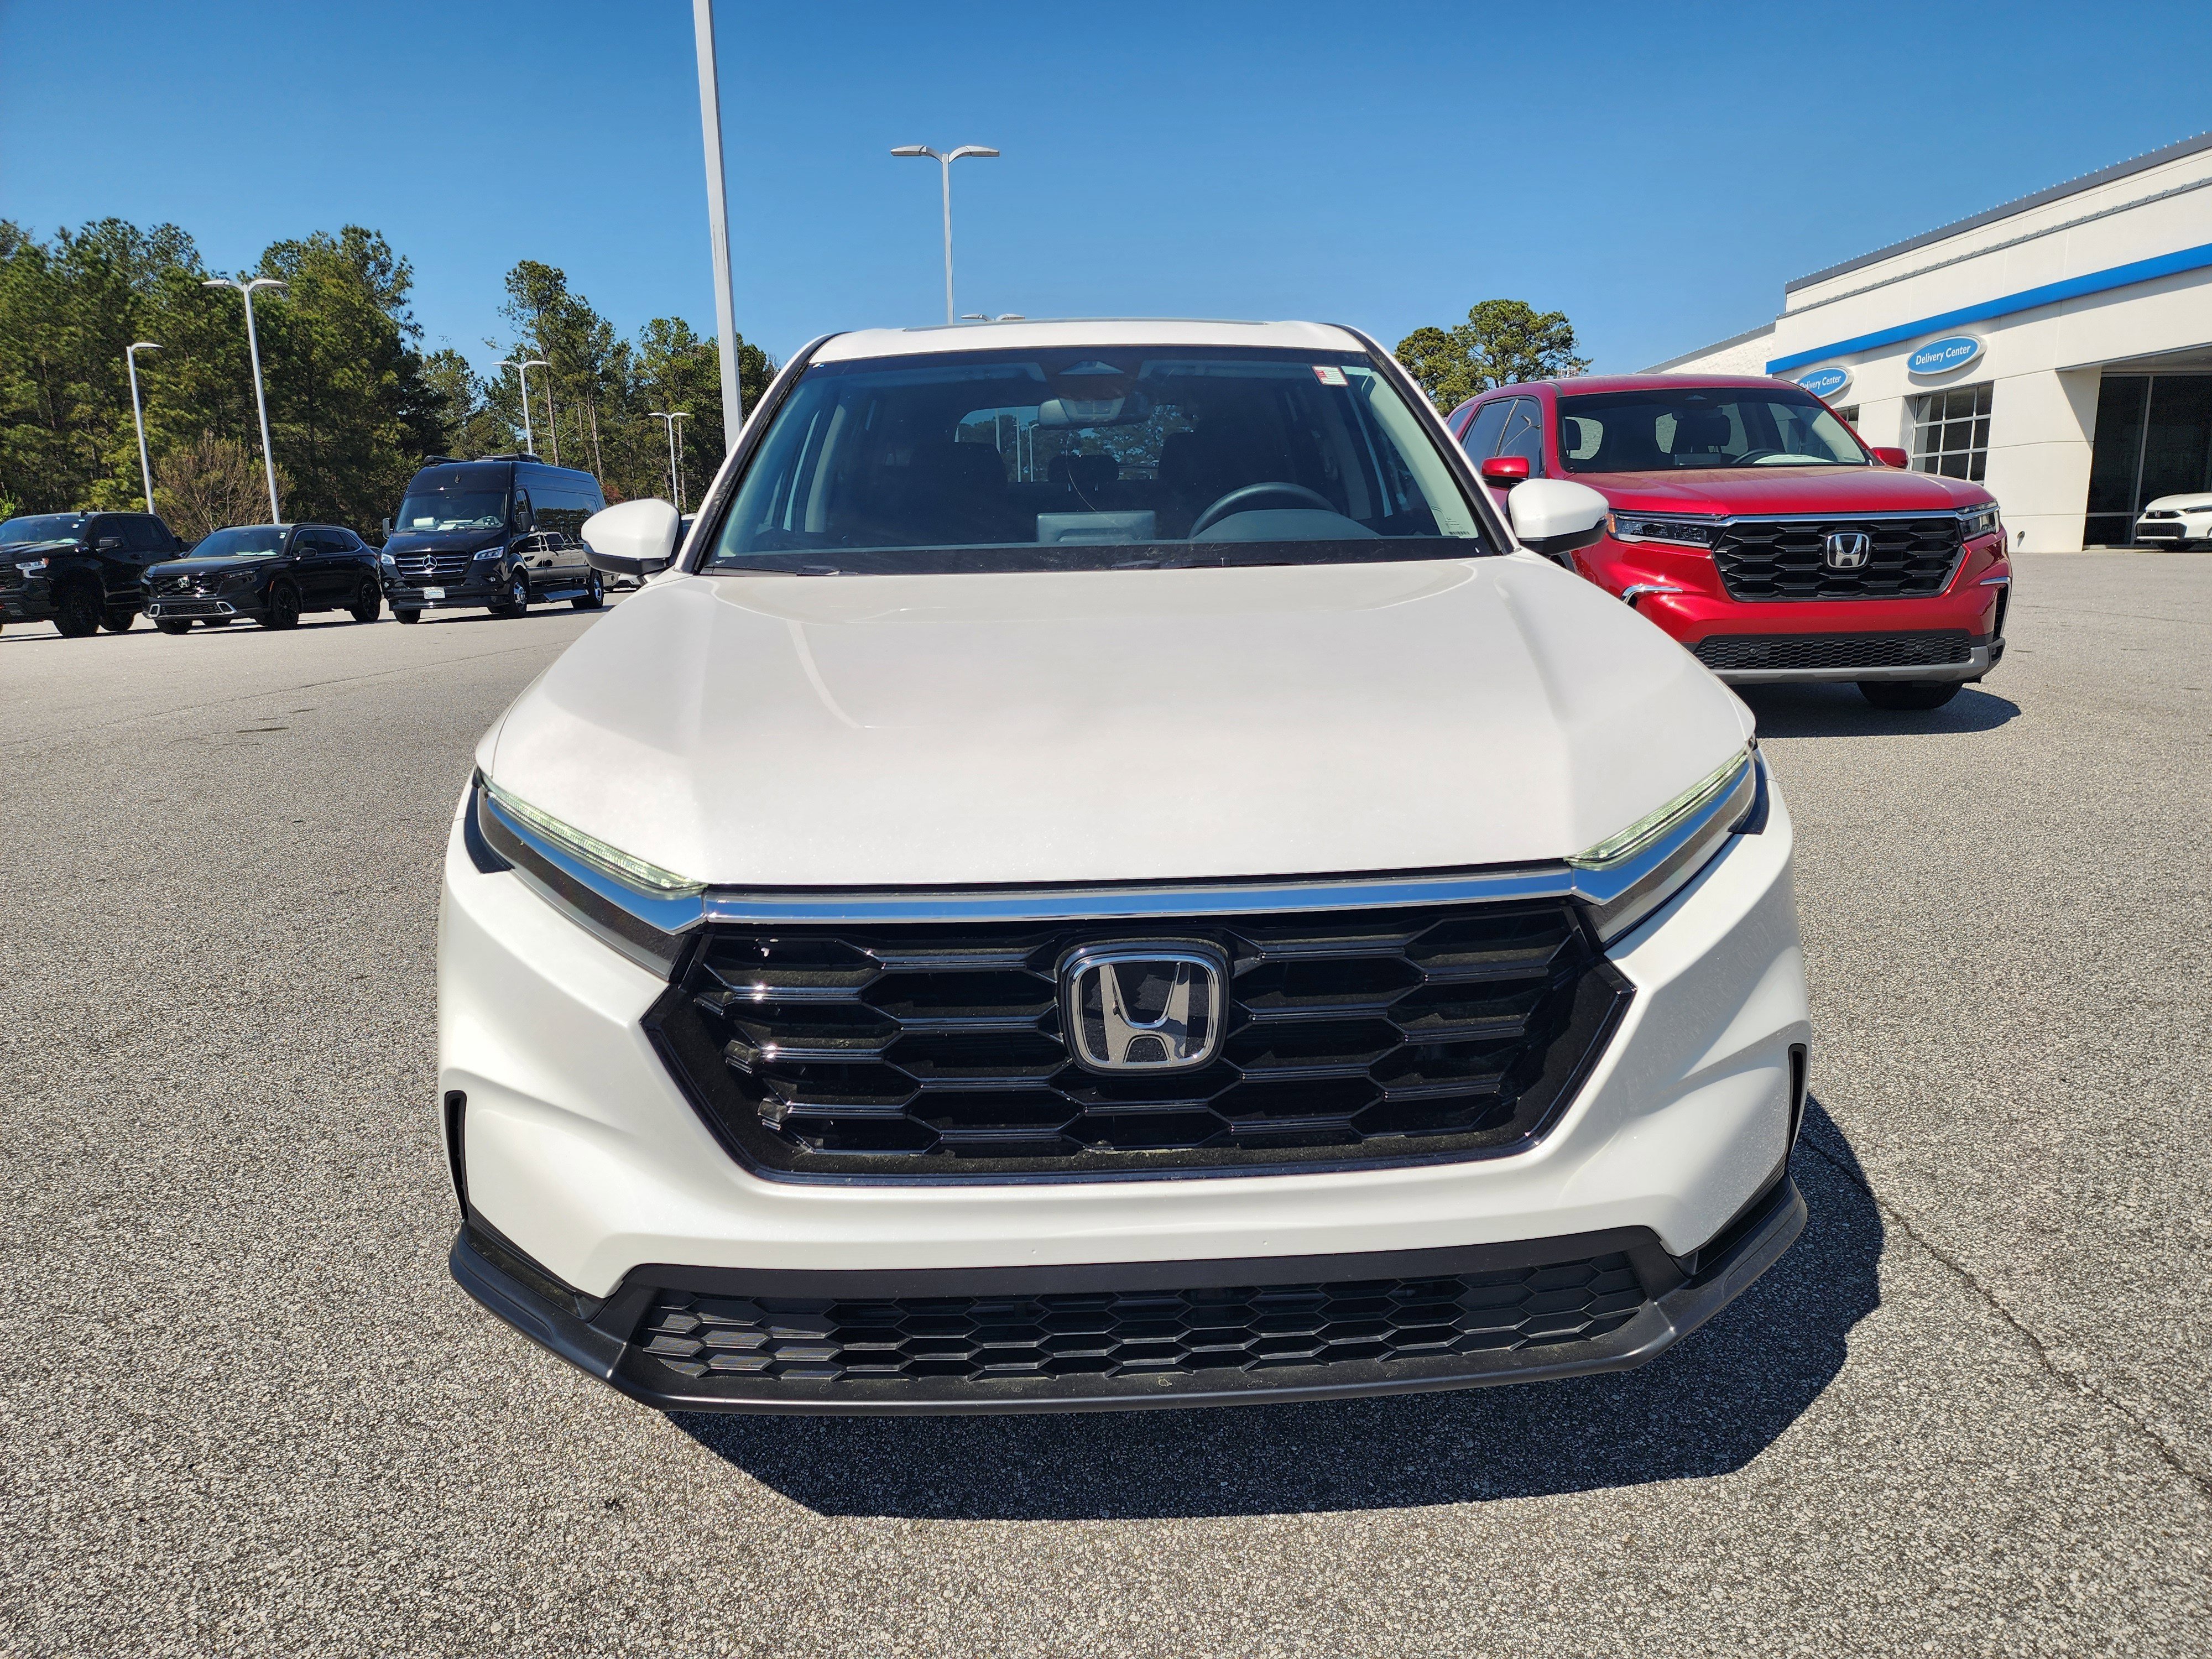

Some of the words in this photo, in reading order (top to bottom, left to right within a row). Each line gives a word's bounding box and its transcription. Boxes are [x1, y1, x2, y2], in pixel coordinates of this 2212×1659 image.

[1916, 352, 1944, 365] Delivery
[1945, 345, 1971, 358] Center
[1822, 375, 1841, 386] Center
